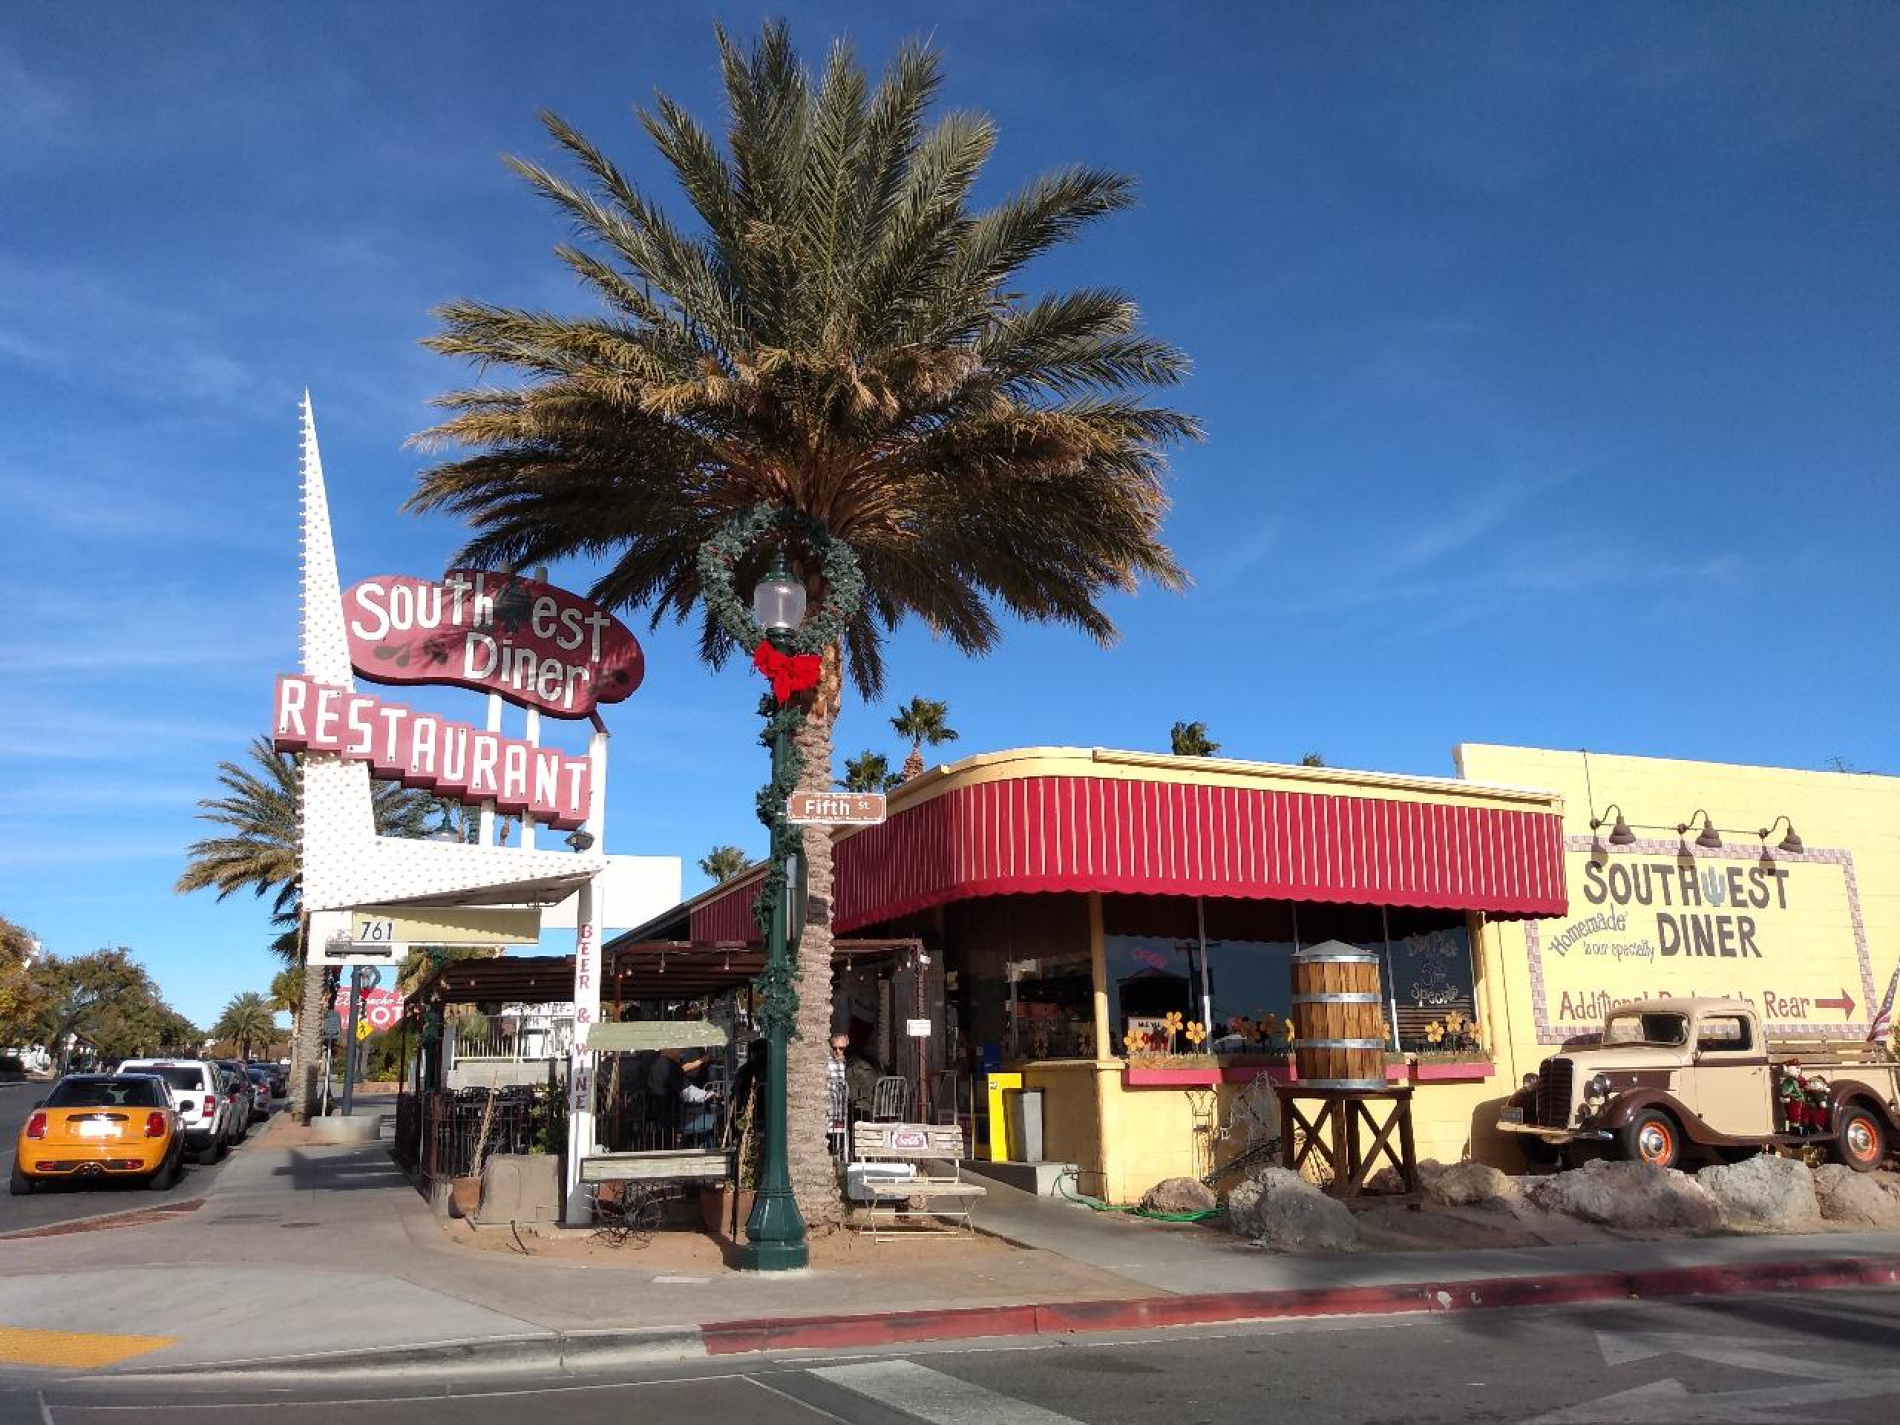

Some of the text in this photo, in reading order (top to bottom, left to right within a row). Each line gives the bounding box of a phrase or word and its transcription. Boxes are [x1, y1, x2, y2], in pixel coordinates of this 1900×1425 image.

[463, 631, 591, 709] Diner
[278, 678, 588, 814] RESTAURANT
[805, 799, 850, 816] Fifth
[360, 921, 393, 941] 761
[1656, 912, 1763, 958] DINER
[575, 925, 593, 1110] BEER & WINE
[1763, 990, 1810, 1019] Rear
